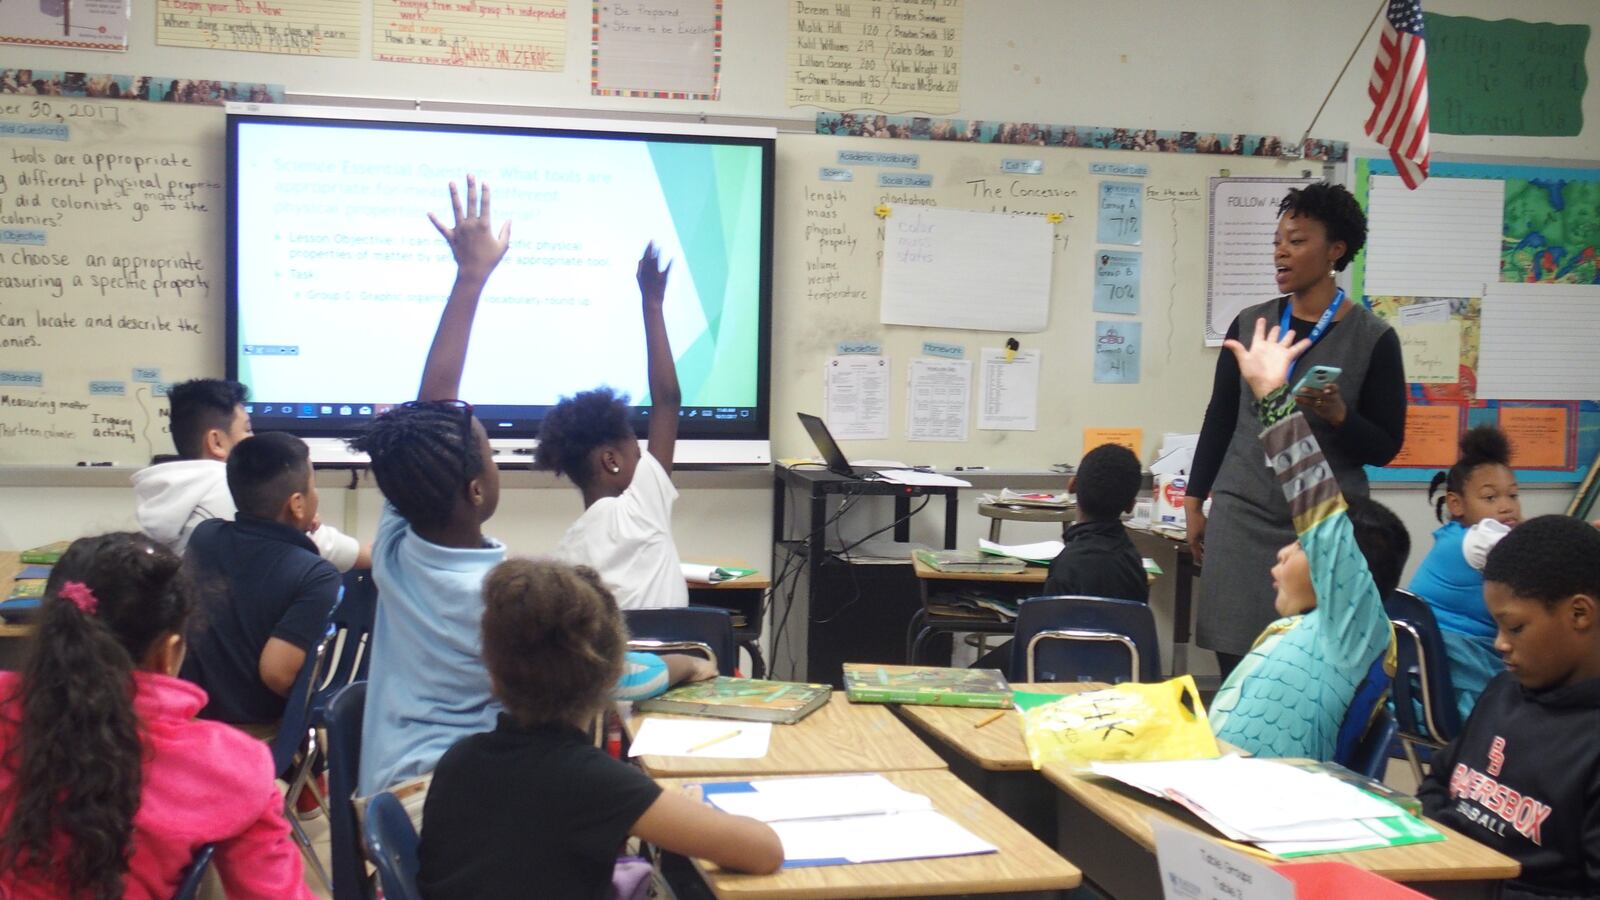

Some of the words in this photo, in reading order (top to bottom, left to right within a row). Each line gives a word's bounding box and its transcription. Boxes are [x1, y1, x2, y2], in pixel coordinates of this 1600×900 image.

[614, 3, 630, 16] Be
[638, 4, 680, 18] Prepared
[162, 13, 191, 28] When
[862, 24, 879, 36] 120
[827, 55, 853, 72] George
[69, 103, 120, 122] 2017
[11, 147, 47, 166] tools
[54, 153, 76, 165] are
[82, 153, 192, 173] appropriate
[341, 160, 413, 177] Essential
[499, 167, 539, 182] What
[545, 168, 582, 184] tools
[588, 171, 612, 185] are
[19, 168, 88, 187] different
[94, 172, 163, 195] physical
[966, 179, 1003, 198] The
[1010, 180, 1079, 198] Concession
[804, 185, 847, 209] length
[1128, 198, 1137, 210] A
[1227, 196, 1266, 208] FOLLOW
[16, 194, 42, 207] did
[51, 195, 123, 212] colonists
[132, 202, 150, 223] go
[160, 201, 177, 212] to
[183, 199, 209, 213] the
[807, 209, 838, 219] mass
[1, 212, 64, 228] colonies?
[289, 231, 330, 244] Lesson
[805, 223, 846, 241] physical
[819, 235, 857, 256] property
[86, 254, 107, 267] an
[112, 251, 205, 280] appropriate
[1125, 267, 1134, 276] B
[0, 275, 64, 298] easuring
[73, 275, 84, 288] a
[91, 271, 148, 297] specific
[152, 274, 210, 298] property
[807, 273, 841, 289] weight
[807, 287, 868, 304] temperature
[36, 309, 77, 328] locate
[85, 314, 113, 329] and
[117, 314, 173, 332] describe
[177, 319, 203, 334] the
[0, 335, 42, 348] onies.
[923, 343, 964, 355] Homework
[1125, 343, 1136, 356] C
[92, 383, 126, 393] Science
[1, 395, 57, 415] Measuring
